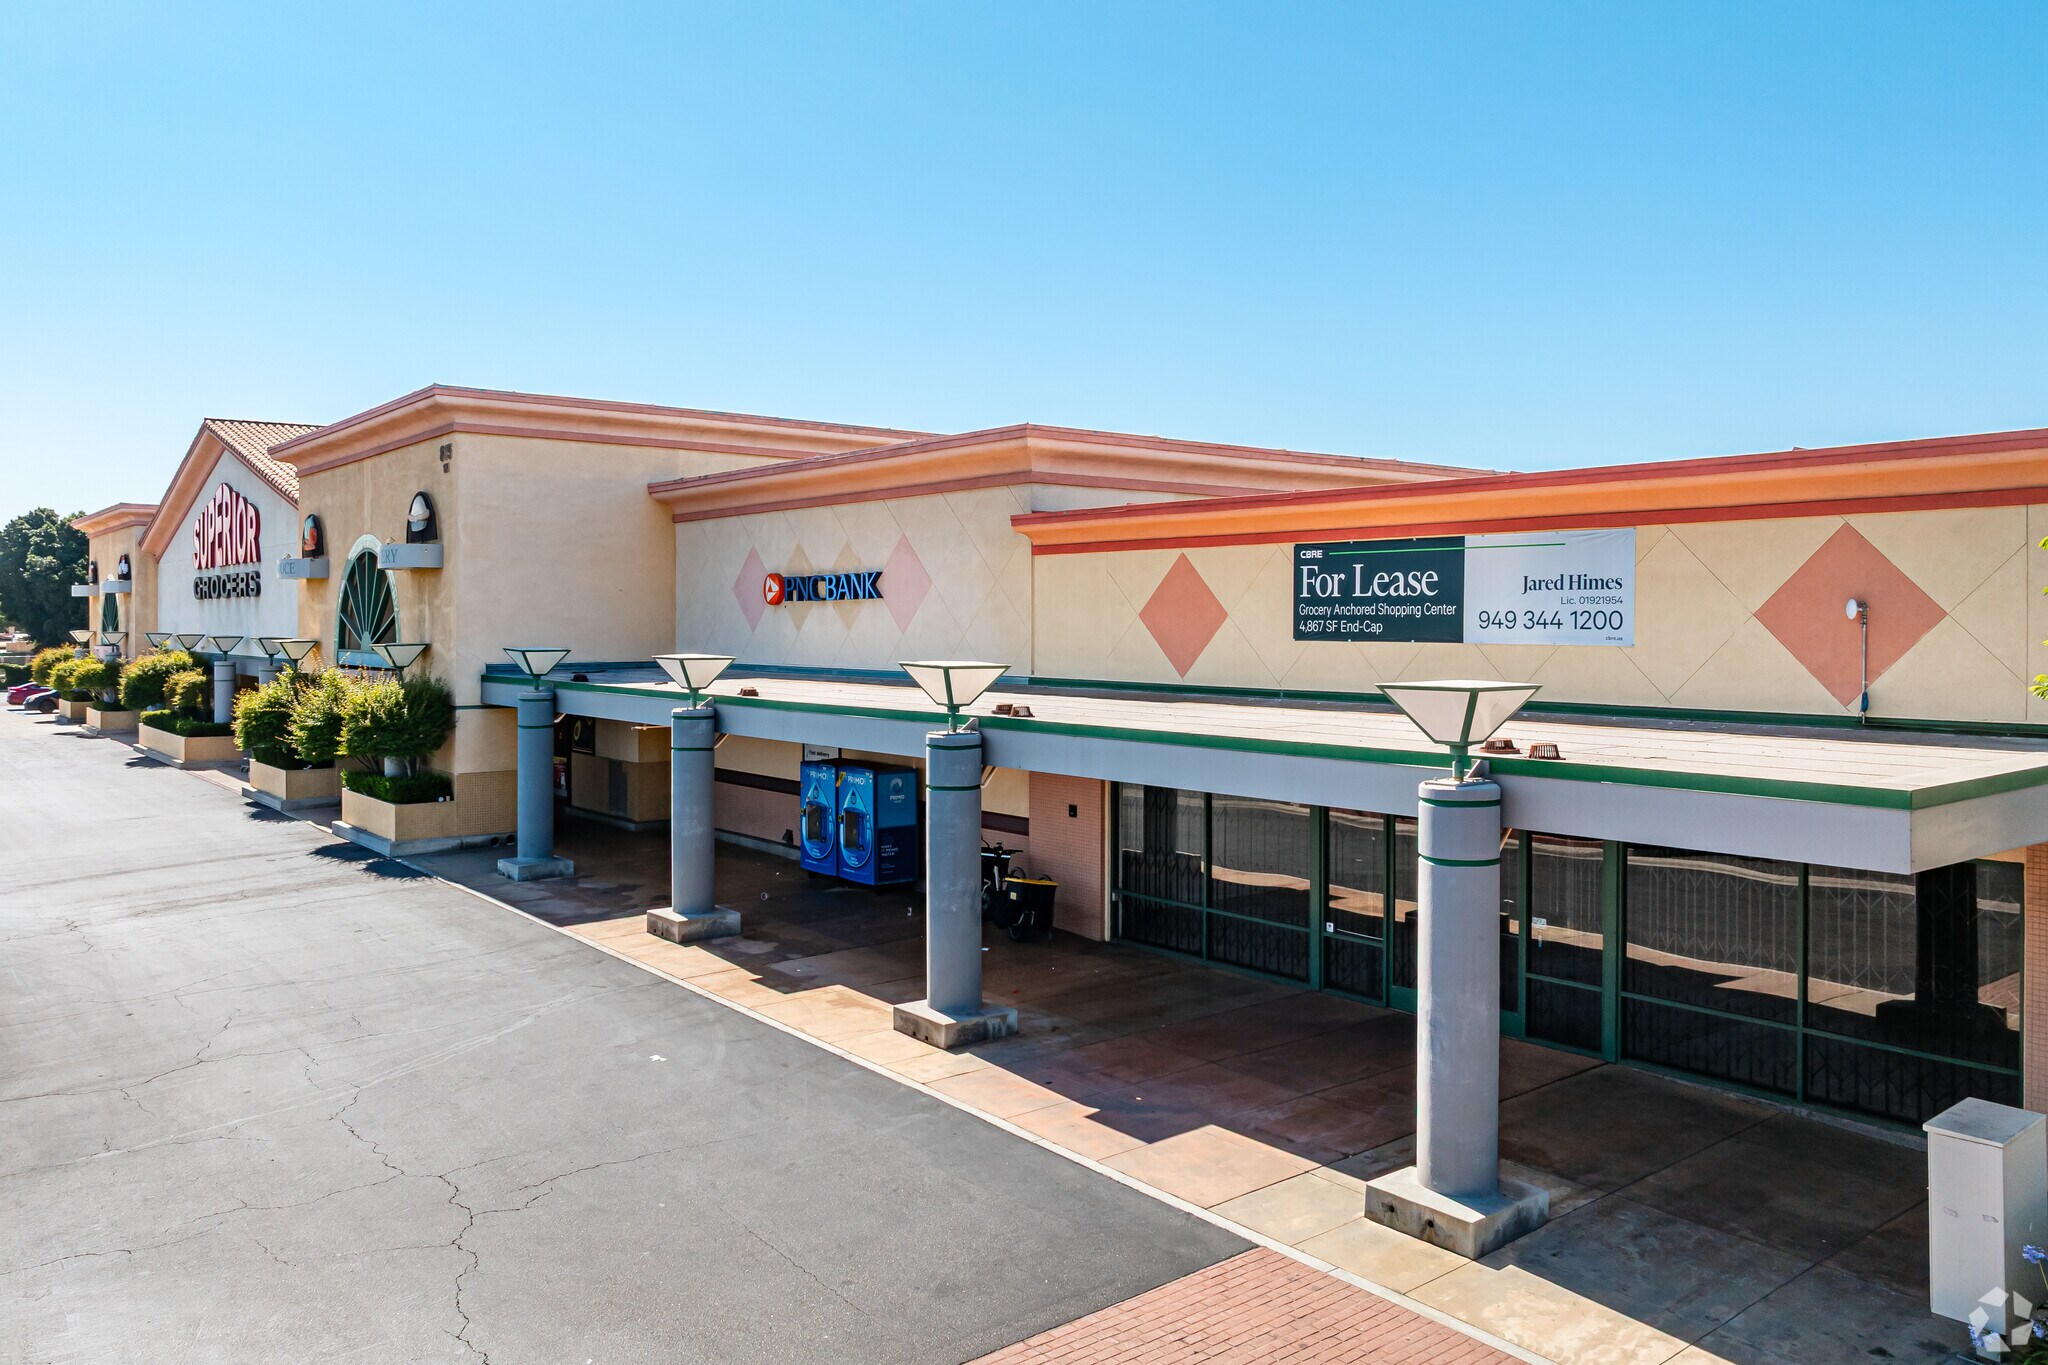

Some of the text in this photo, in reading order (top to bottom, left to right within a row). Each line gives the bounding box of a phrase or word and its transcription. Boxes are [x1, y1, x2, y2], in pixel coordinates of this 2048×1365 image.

[193, 483, 262, 570] SUPERIOR
[1300, 550, 1323, 559] CBRE
[193, 570, 262, 600] GROCERS
[784, 571, 883, 601] PNC BANK
[1300, 563, 1439, 598] For Lease
[1521, 573, 1623, 595] Jared Himes
[1560, 596, 1624, 605] Lic. 01921954
[1299, 603, 1457, 618] Grocery Anchored Shopping Center
[1299, 620, 1383, 635] 4,867 SF End-Cap
[1478, 610, 1624, 631] 949 344 1200
[809, 770, 827, 780] PRIMO
[847, 775, 865, 785] PRIMO
